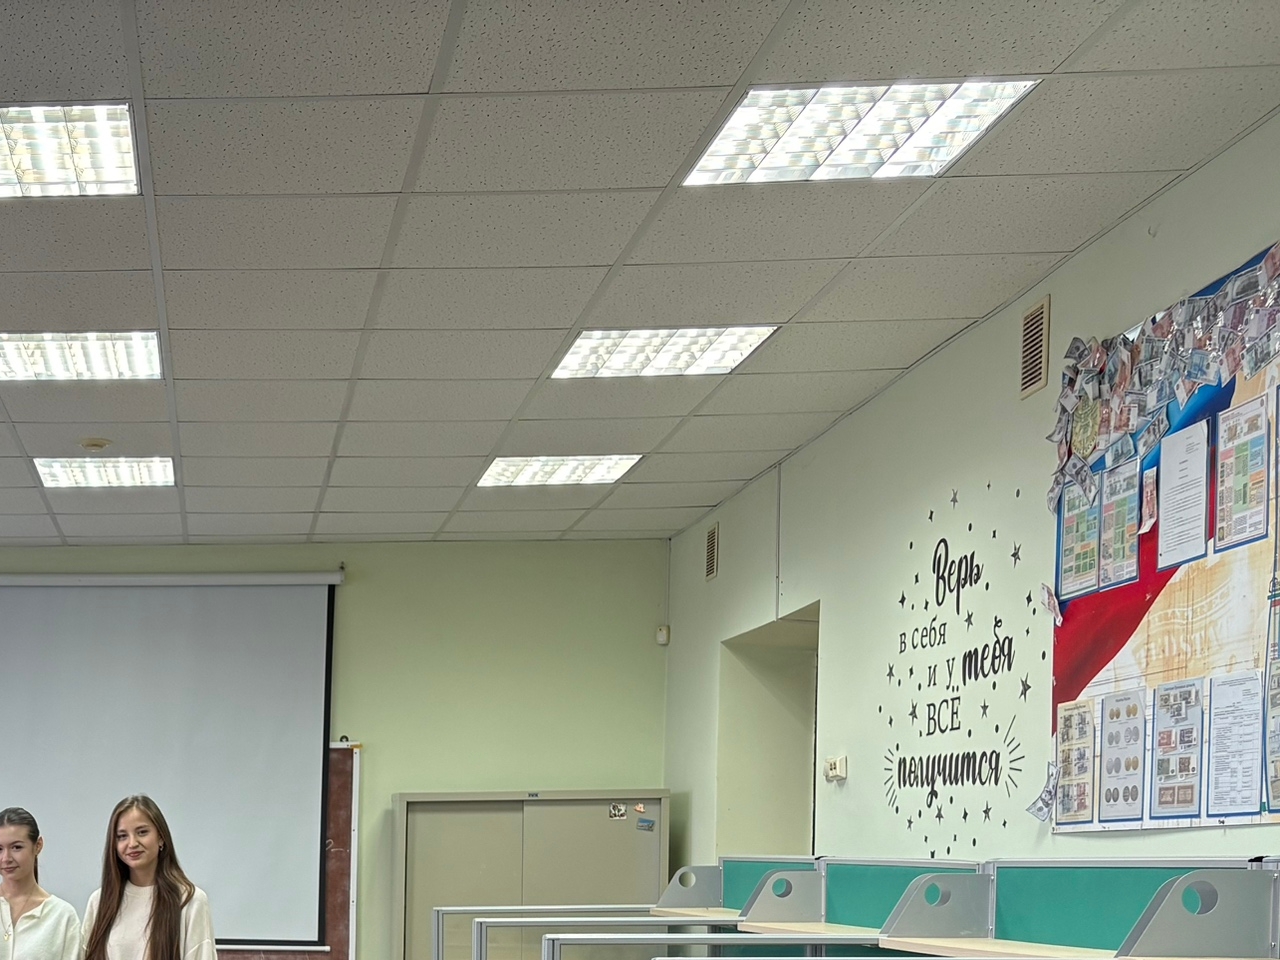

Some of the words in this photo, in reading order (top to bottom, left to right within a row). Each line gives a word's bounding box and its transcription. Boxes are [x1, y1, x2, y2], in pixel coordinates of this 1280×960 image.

[931, 537, 984, 616] Верь
[899, 632, 907, 654] в
[911, 615, 947, 650] себя
[927, 664, 937, 688] и
[946, 656, 956, 691] у
[962, 616, 1016, 687] тебя
[925, 685, 961, 737] ВСЁ
[897, 748, 1004, 809] получится
